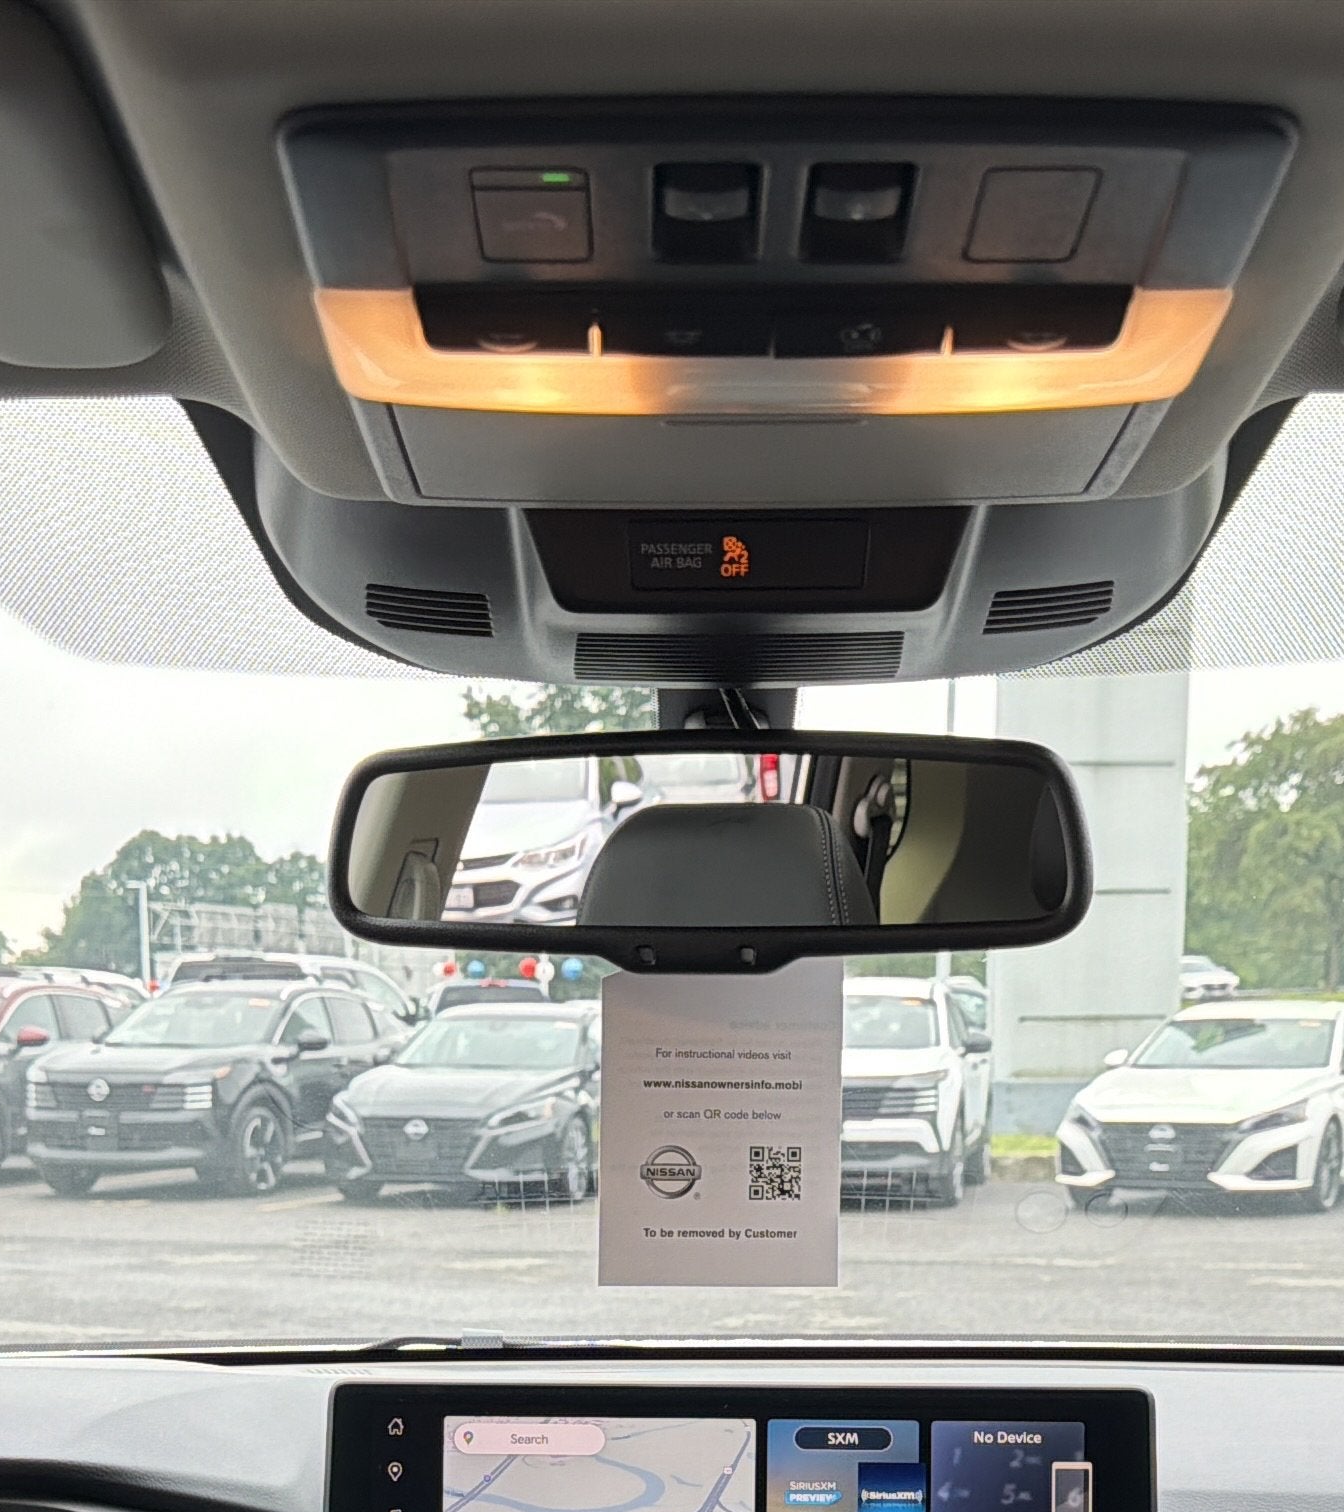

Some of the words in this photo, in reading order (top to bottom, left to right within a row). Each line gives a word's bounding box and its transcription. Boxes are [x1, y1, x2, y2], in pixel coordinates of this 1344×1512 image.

[641, 544, 712, 554] PASSENGER
[651, 557, 672, 568] AIR
[677, 557, 702, 568] BAG
[720, 564, 749, 577] OFF
[656, 1048, 671, 1058] For
[675, 1048, 735, 1060] instructional
[738, 1049, 769, 1060] videos
[772, 1050, 791, 1060] visit
[643, 1079, 802, 1090] www.nissanownersinfo.mobi
[663, 1111, 674, 1119] or
[677, 1110, 700, 1119] scan
[704, 1109, 721, 1120] QR
[724, 1110, 749, 1120] code
[752, 1110, 781, 1120] below
[646, 1167, 696, 1177] NISSAN
[643, 1228, 656, 1238] To
[660, 1228, 674, 1238] be
[678, 1228, 725, 1238] removed
[729, 1229, 741, 1240] by
[745, 1229, 797, 1239] Customer
[510, 1434, 549, 1445] Search
[827, 1433, 859, 1445] SXM
[974, 1431, 993, 1444] No
[998, 1431, 1042, 1444] Device
[789, 1493, 834, 1503] PREVIEW
